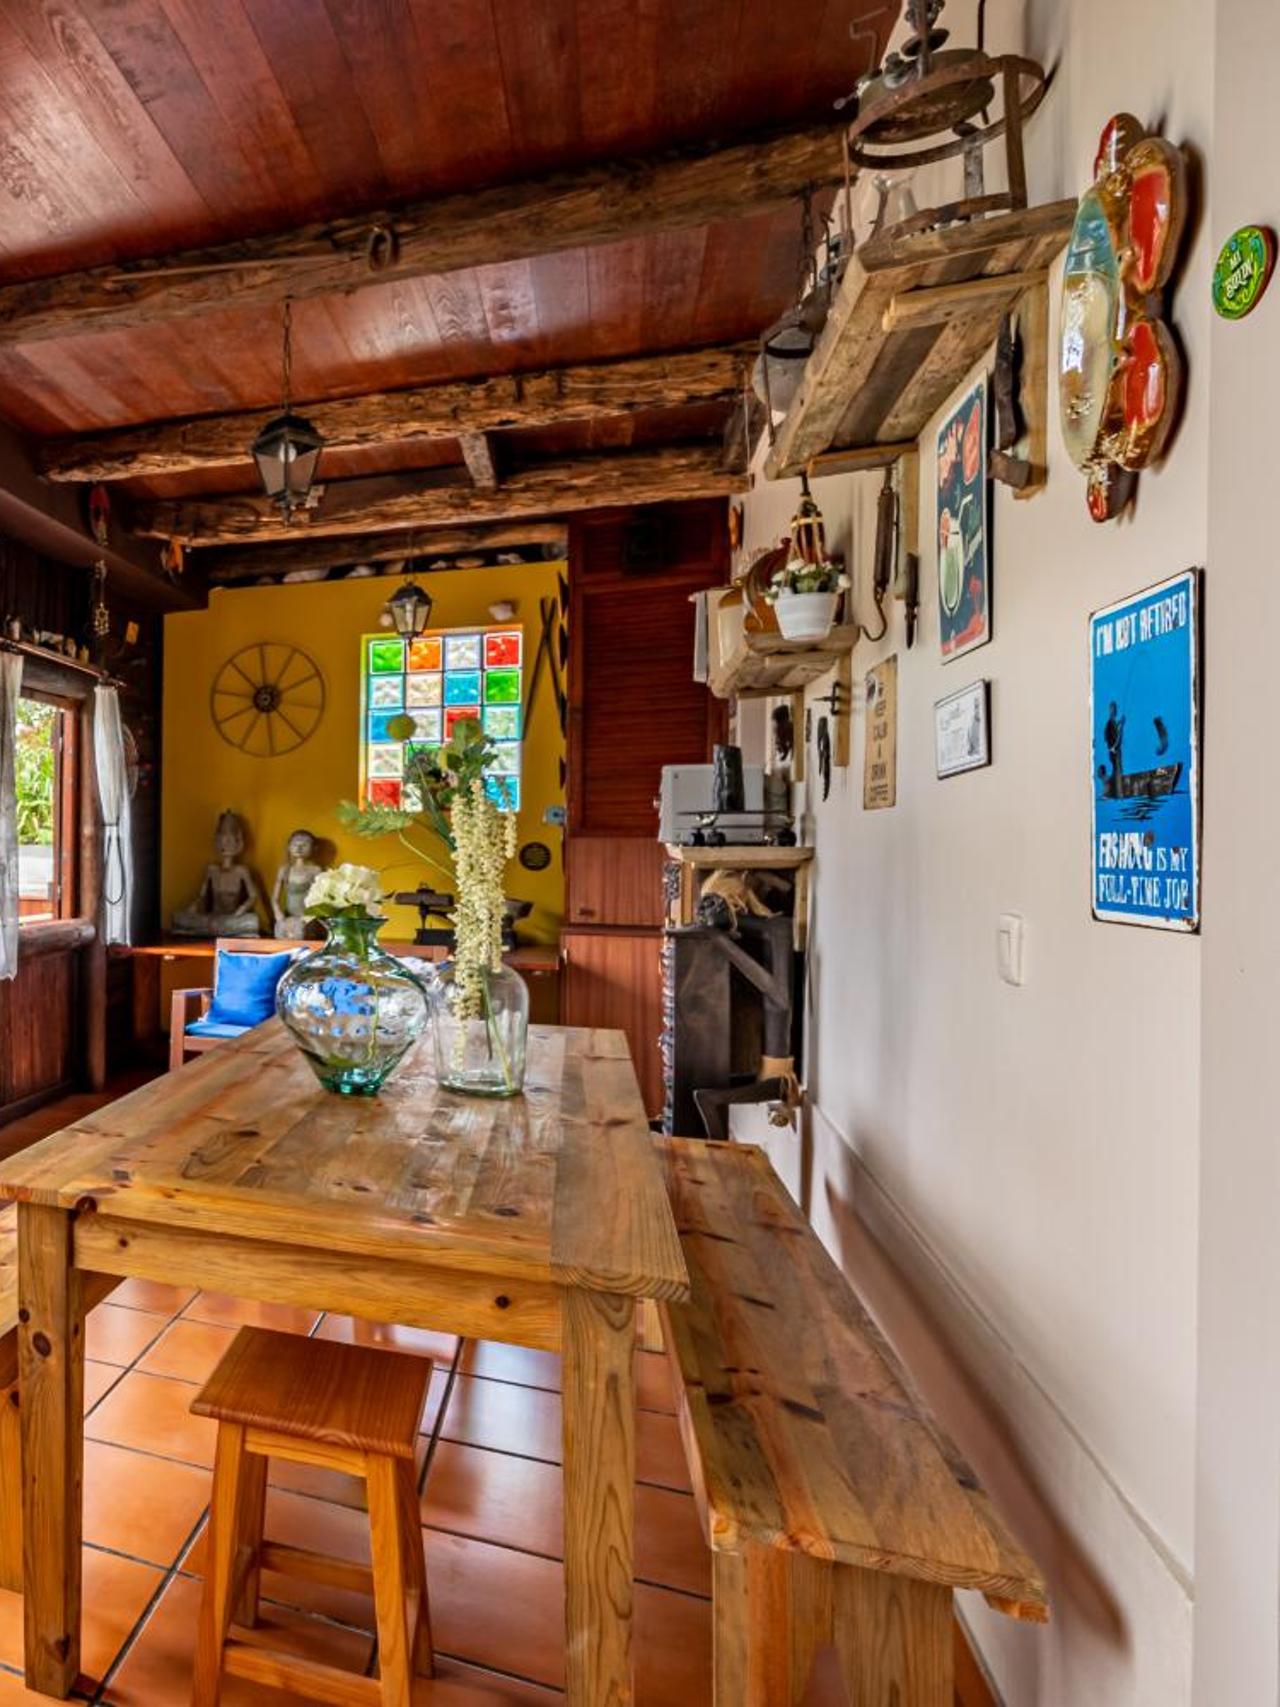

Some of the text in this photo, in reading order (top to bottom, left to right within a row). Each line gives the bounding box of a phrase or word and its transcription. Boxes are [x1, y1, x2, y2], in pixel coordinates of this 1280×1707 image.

[1096, 591, 1187, 657] I'M NOT RETIRED
[1099, 831, 1189, 872] FISHING IS MY
[1099, 873, 1189, 911] FULL-TIME JOB
